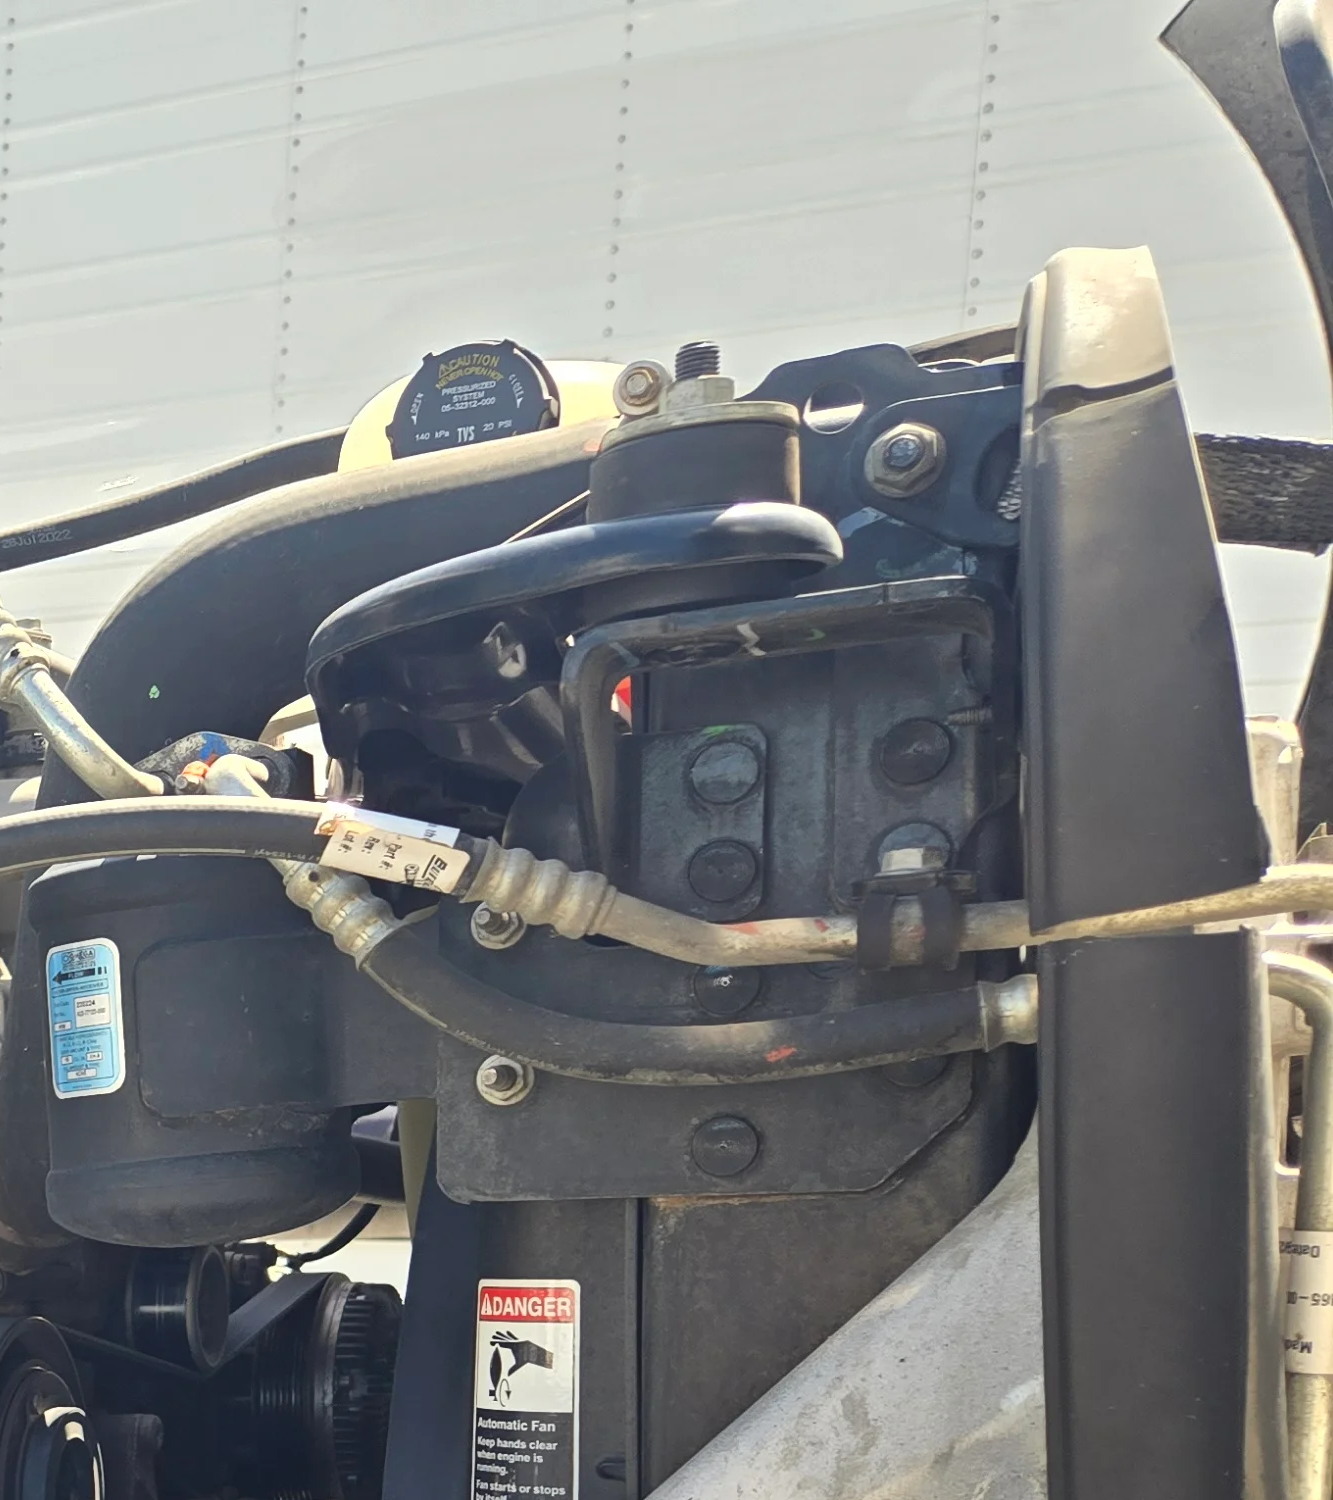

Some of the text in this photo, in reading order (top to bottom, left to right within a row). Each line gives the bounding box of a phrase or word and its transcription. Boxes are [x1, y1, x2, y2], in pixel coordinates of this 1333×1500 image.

[449, 354, 500, 371] CAUTION
[435, 367, 505, 390] NEVER OPEN HOT
[442, 380, 496, 396] PRESSURIZED
[453, 391, 485, 402] SYSTEM
[483, 419, 513, 432] 20 PSI
[415, 430, 450, 441] 140 kPa
[457, 426, 475, 443] TVS
[383, 843, 403, 859] Part
[493, 1296, 572, 1317] DANGER
[477, 1417, 556, 1432] Automatic Fan
[477, 1436, 558, 1450] Keep hands clear
[477, 1450, 543, 1464] when engine is
[477, 1463, 509, 1476] running.
[476, 1479, 566, 1496] Fan starts or stops
